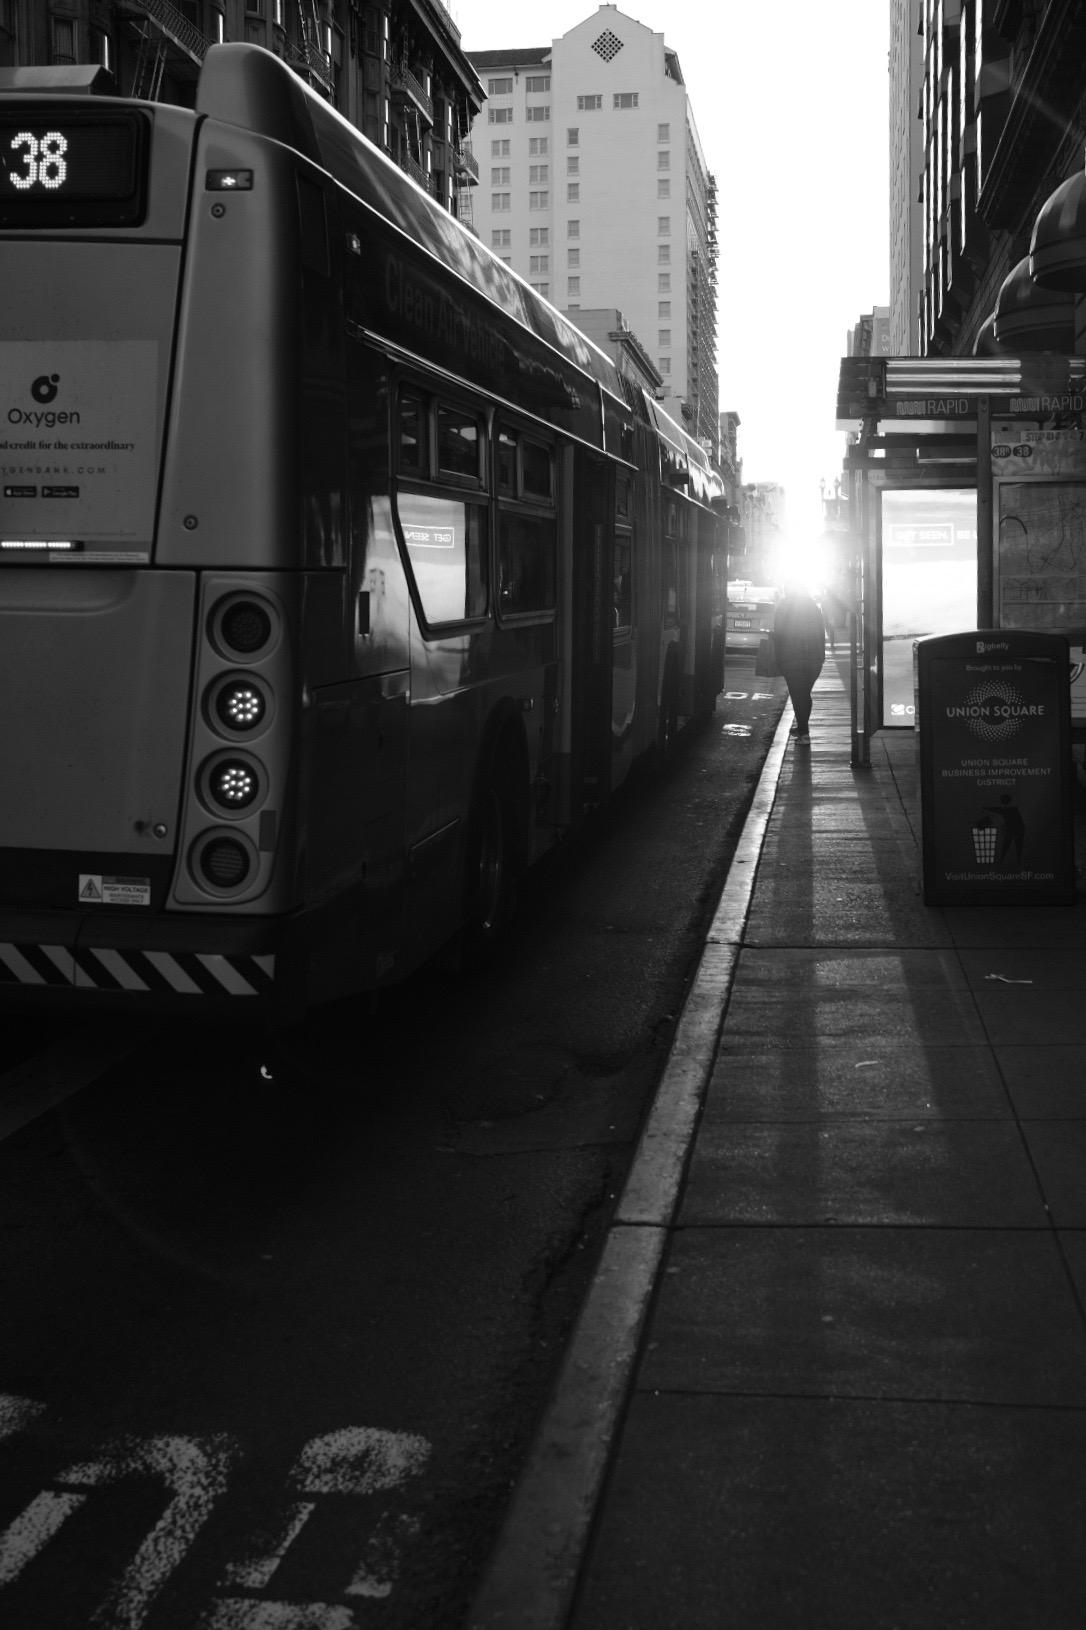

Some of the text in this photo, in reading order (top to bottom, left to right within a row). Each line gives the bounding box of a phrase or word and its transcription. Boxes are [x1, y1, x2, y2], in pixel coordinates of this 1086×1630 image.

[10, 132, 67, 188] 38
[927, 399, 969, 415] RAPID
[1041, 396, 1083, 412] RAPID
[8, 408, 80, 428] Oxygen
[10, 440, 36, 449] credit
[39, 440, 52, 449] for
[54, 440, 68, 449] the
[70, 440, 134, 452] extraordinary
[946, 705, 1046, 718] UNION SQUARE
[961, 758, 1029, 767] UNION SQUARE
[942, 767, 1051, 777] BUSINESS IMPROVEMENT
[977, 778, 1016, 786] DISTRICT
